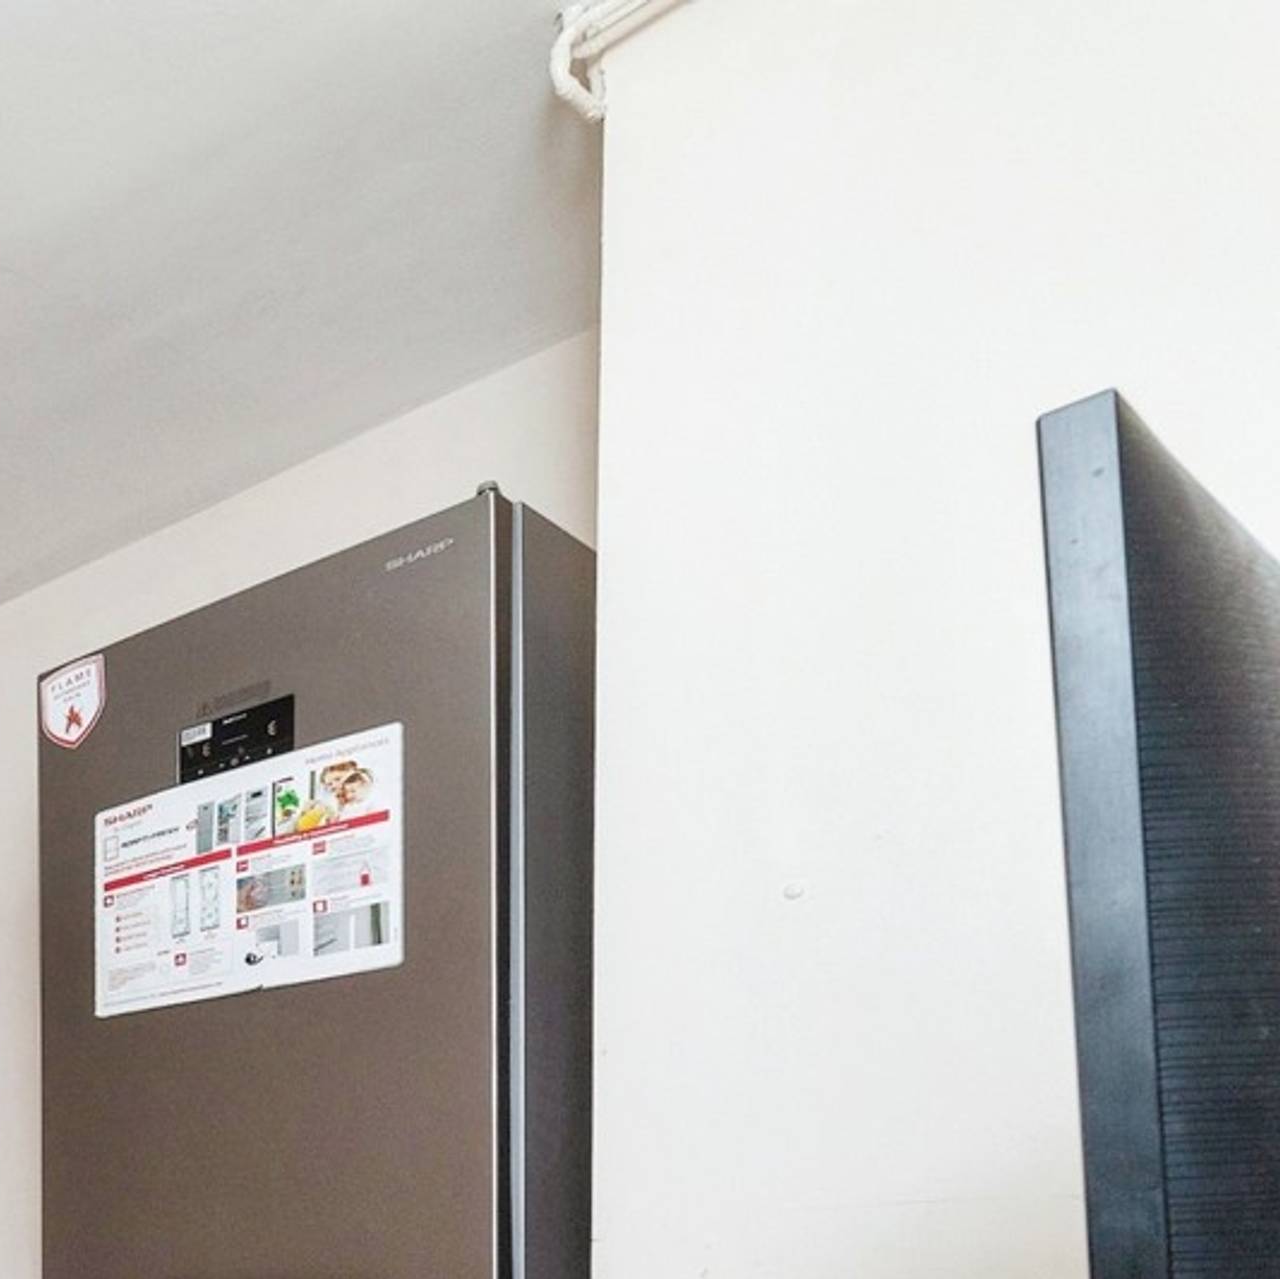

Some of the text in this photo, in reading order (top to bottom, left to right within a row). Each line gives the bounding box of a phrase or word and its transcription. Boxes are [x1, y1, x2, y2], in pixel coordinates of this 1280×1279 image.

[384, 537, 455, 572] SHARP
[50, 668, 92, 693] FLAME
[103, 803, 153, 826] SHARP
